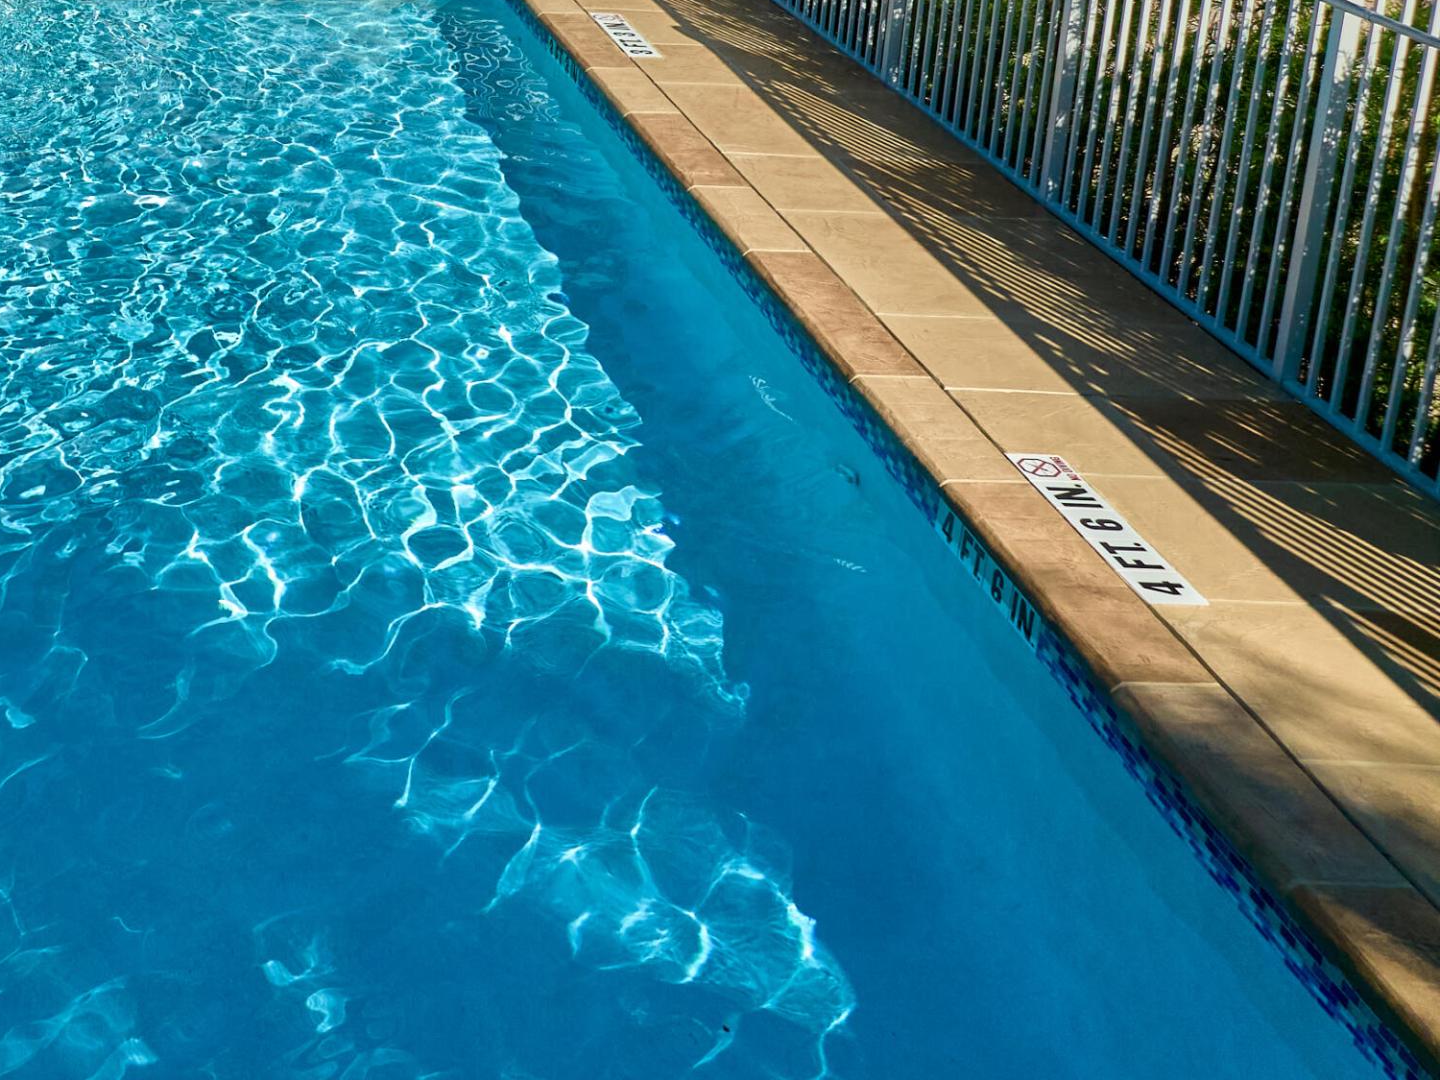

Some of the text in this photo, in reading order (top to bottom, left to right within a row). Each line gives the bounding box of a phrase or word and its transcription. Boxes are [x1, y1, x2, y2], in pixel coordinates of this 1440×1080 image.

[942, 512, 954, 544] 4
[960, 526, 985, 582] FT.
[990, 569, 1005, 604] 6
[1046, 483, 1185, 596] 4 FT. 6 IN.
